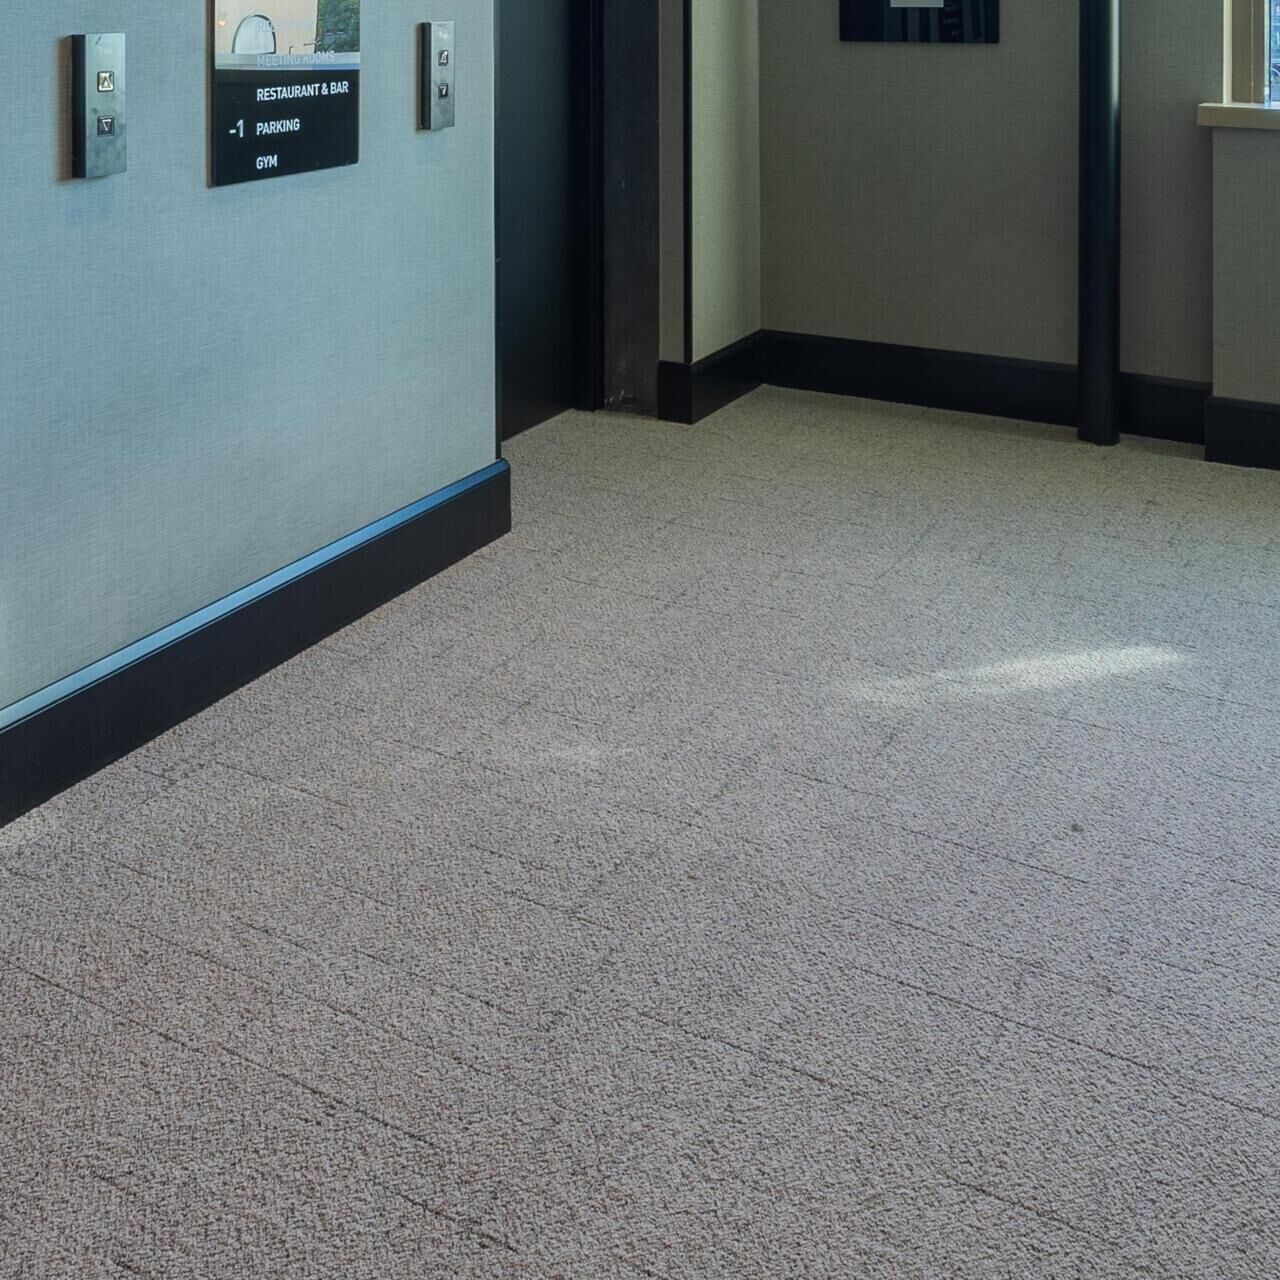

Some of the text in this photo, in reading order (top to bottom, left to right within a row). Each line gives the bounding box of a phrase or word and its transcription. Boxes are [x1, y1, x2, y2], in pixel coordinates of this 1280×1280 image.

[256, 50, 335, 67] MEETING ROOMS
[257, 81, 349, 101] RESTAURANT & BAR
[228, 118, 300, 138] -1 PARKING
[256, 154, 278, 170] GYM
